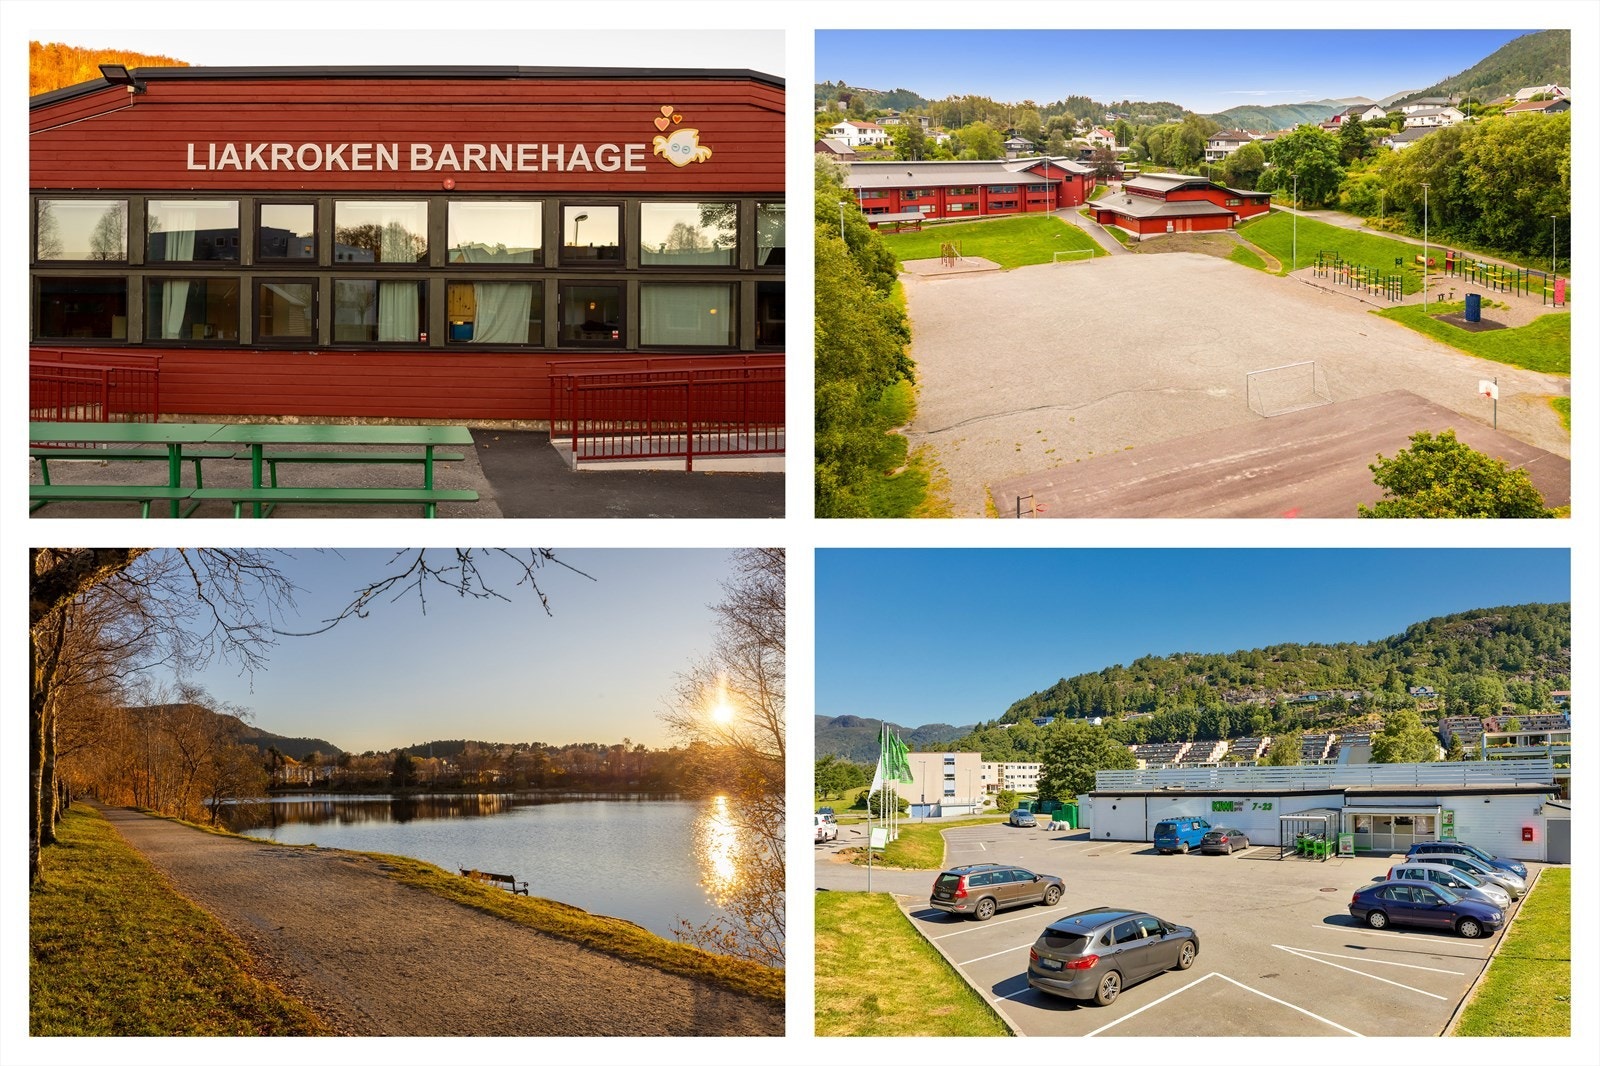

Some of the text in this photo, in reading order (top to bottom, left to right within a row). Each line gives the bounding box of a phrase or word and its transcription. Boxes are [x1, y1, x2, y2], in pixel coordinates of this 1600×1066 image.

[187, 143, 647, 172] LIAKROKEN BARNEHAGE
[1212, 801, 1233, 812] KIWI
